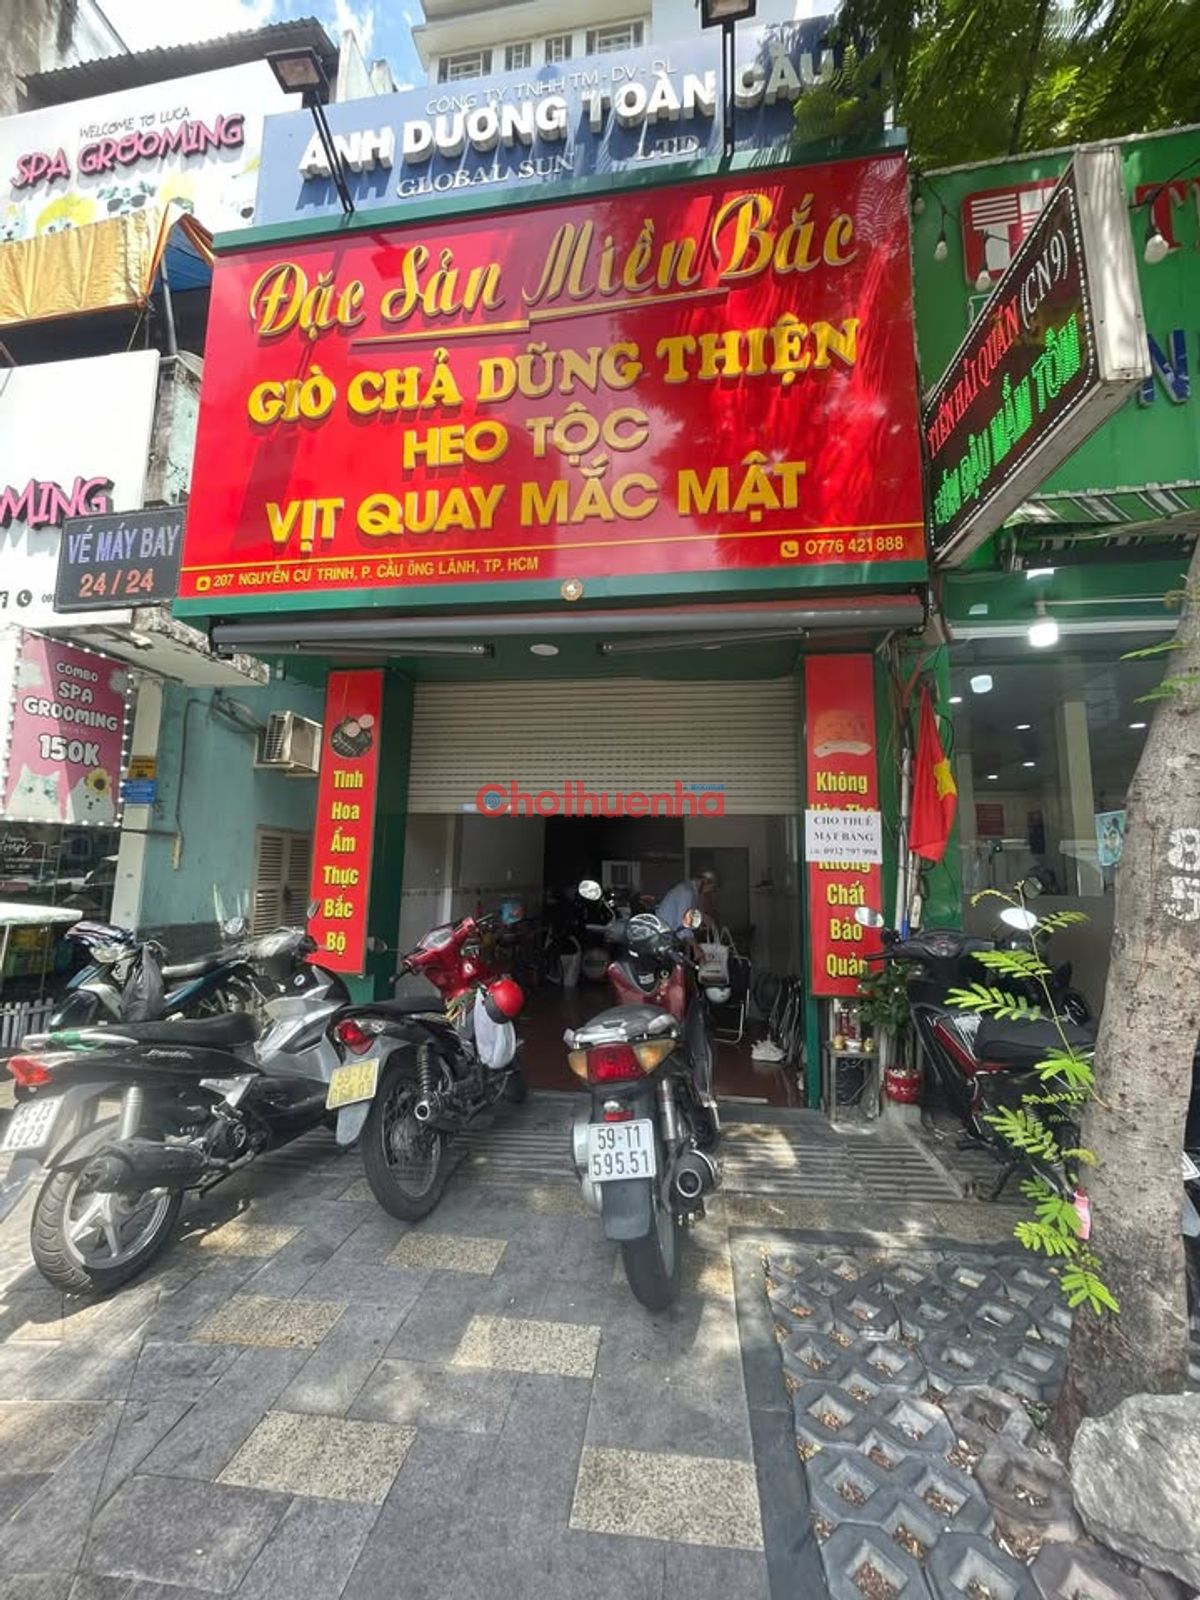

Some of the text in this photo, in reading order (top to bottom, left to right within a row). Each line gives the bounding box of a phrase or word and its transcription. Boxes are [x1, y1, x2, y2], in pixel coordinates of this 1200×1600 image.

[483, 86, 507, 104] TY
[514, 77, 566, 98] TNHH
[80, 106, 191, 138] WELCOME TO LUCA
[402, 95, 568, 160] DƯƠNG
[581, 68, 716, 127] TOÀN
[10, 113, 245, 188] SPA GROOMING
[397, 165, 513, 198] GLOBAL
[518, 154, 576, 180] SUN
[251, 193, 859, 341] Đặc Sản Miền Bắc
[248, 312, 860, 424] GIÒ CHẢ DŨNG THIỆN
[1031, 313, 1081, 414] TÔM
[403, 402, 649, 470] HEO TỘC
[266, 450, 806, 552] VỊT QUAY MẮC MẬT
[68, 522, 180, 564] VÉ MÁY BAY
[805, 535, 904, 555] 0776 421 888
[213, 573, 234, 588] 207
[508, 556, 539, 571] HCM
[56, 662, 98, 682] COMBO
[58, 681, 93, 704] SPA
[23, 696, 118, 731] GROOMING
[39, 734, 100, 766] 150K
[333, 770, 363, 788] Tinh
[816, 771, 868, 794] Không
[331, 802, 360, 820] Hoa
[323, 866, 360, 889] Thực
[324, 893, 354, 918] Bắc
[826, 880, 866, 905] Chất
[830, 916, 863, 941] Bảo
[326, 931, 347, 956] Bộ
[593, 1150, 649, 1176] 595.51
